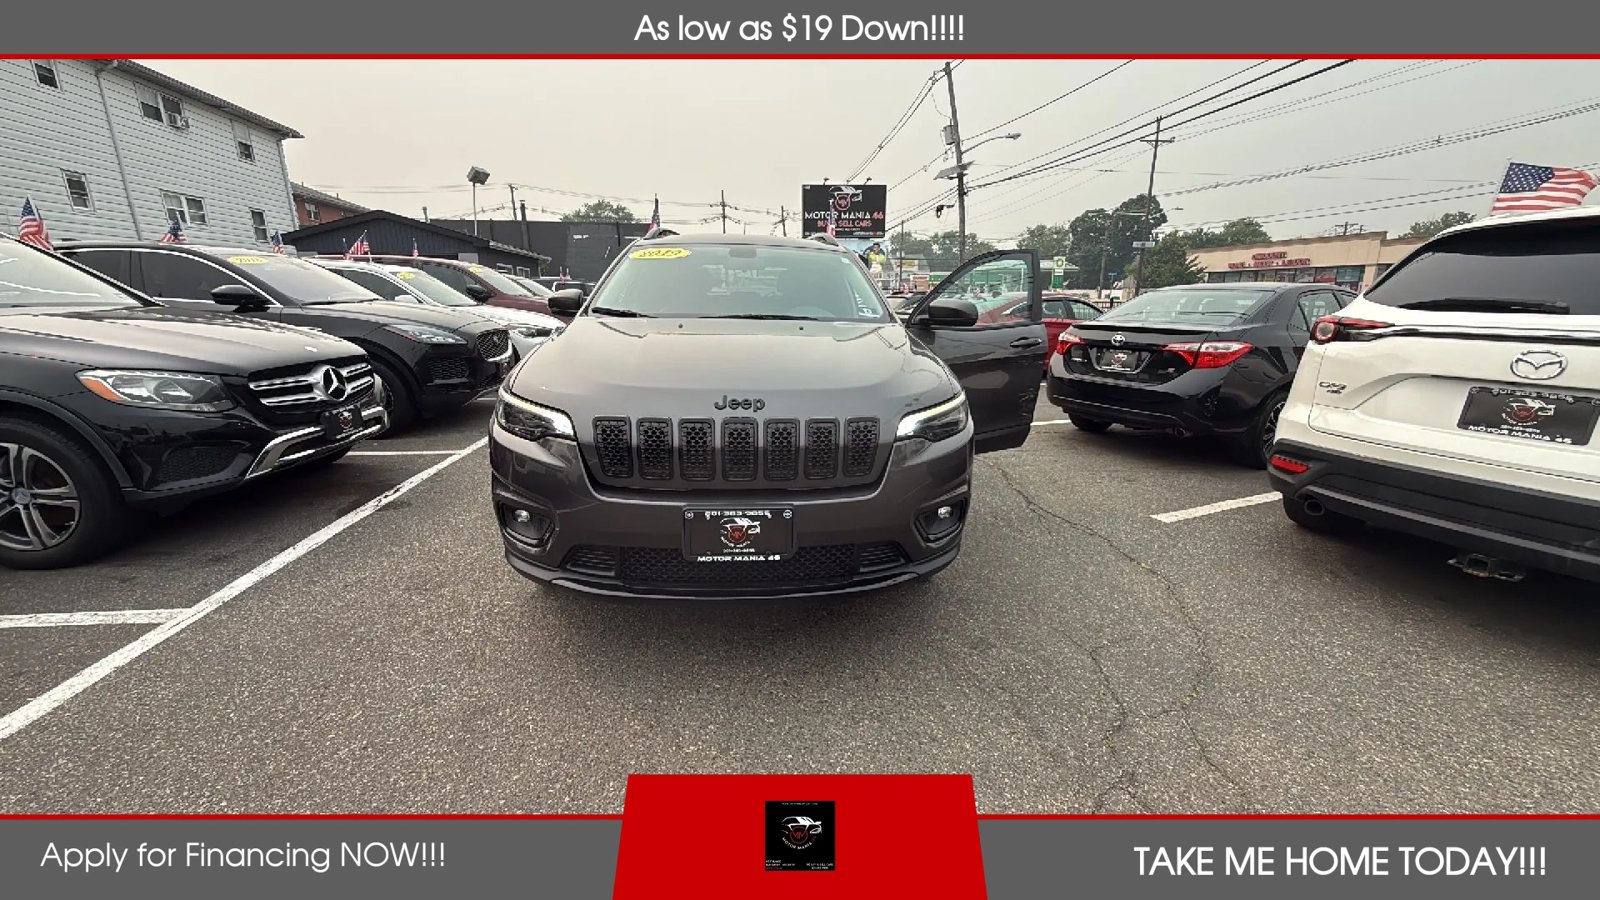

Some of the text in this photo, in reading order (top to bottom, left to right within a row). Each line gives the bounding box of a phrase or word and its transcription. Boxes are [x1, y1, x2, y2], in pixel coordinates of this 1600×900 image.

[804, 211, 884, 219] MOTOR MANIA 46
[713, 394, 766, 413] Jeep
[1468, 425, 1509, 435] MOTOR
[1511, 431, 1551, 440] MANIA
